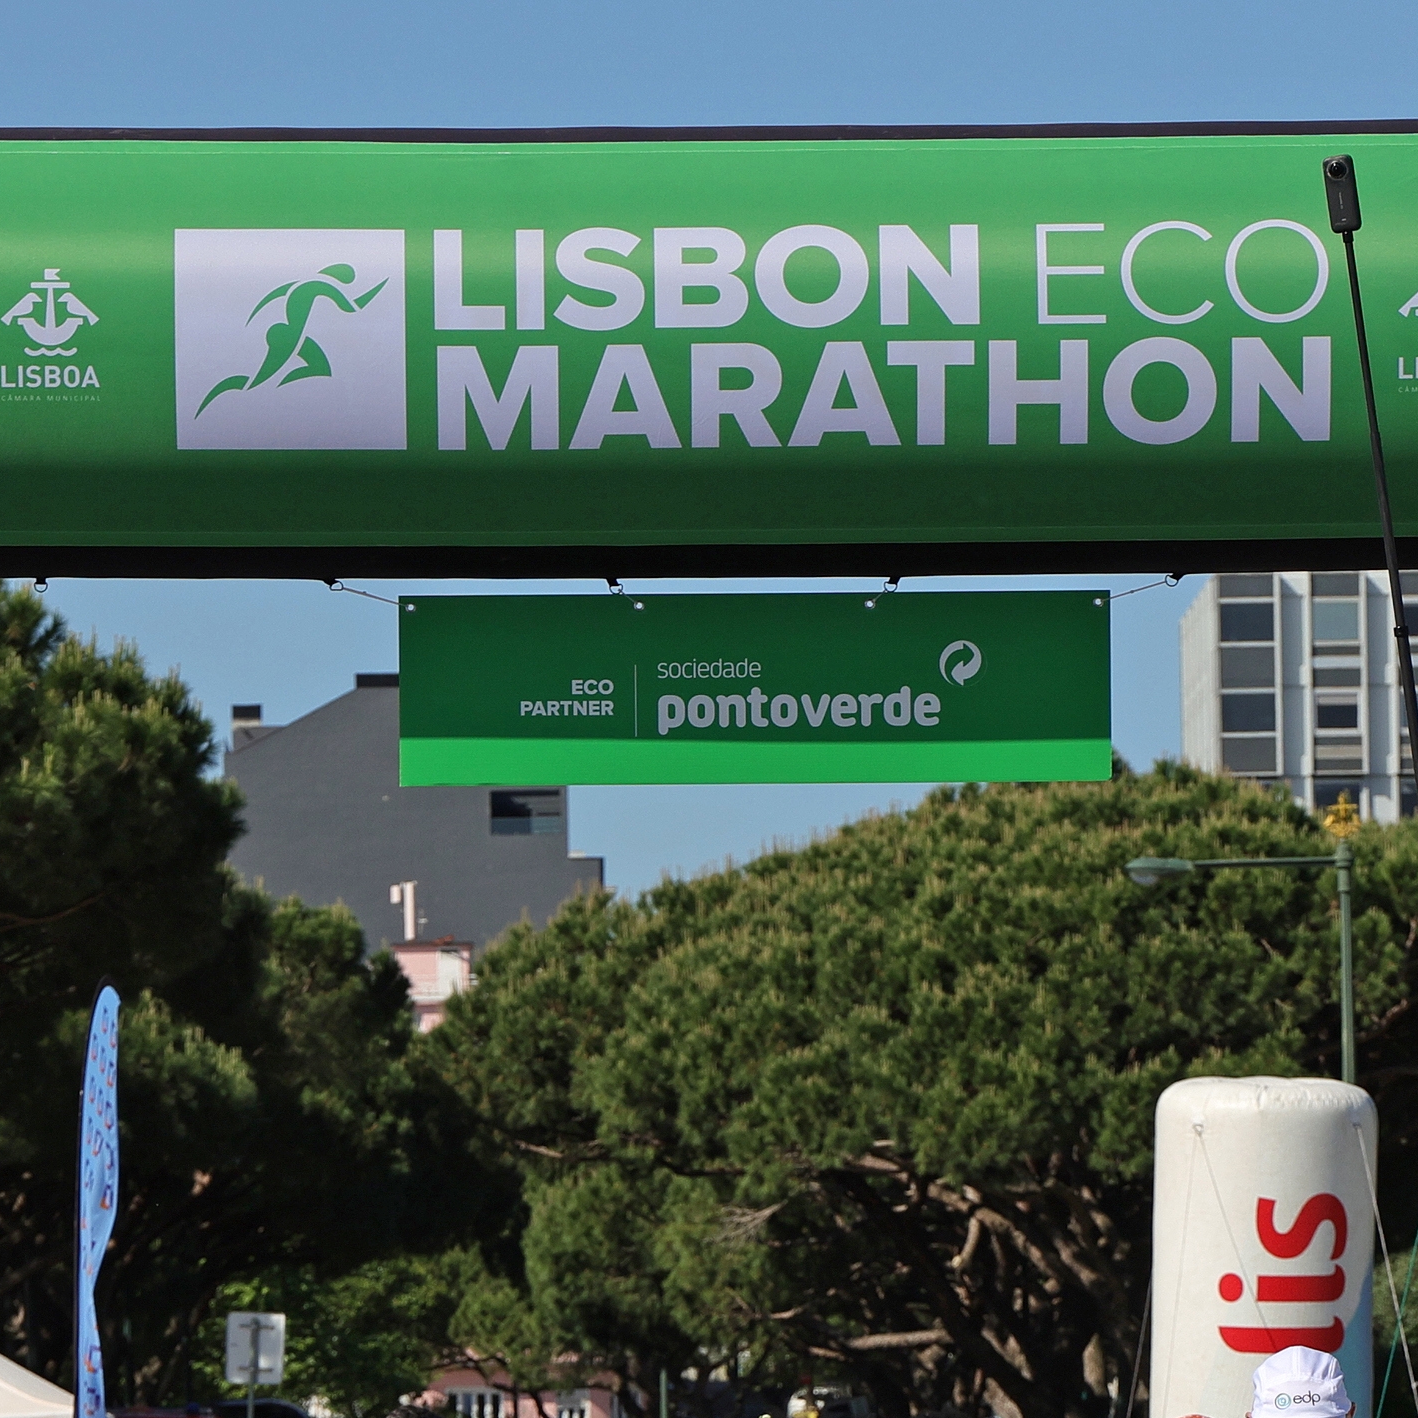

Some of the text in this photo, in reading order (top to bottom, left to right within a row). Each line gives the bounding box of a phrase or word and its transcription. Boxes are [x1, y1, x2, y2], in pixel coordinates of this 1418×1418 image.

[434, 219, 1330, 331] LISBON ECO
[1, 365, 100, 388] LISBOA
[436, 336, 1331, 451] MARATHON
[657, 659, 761, 679] sociedade
[571, 679, 614, 696] ECO
[520, 701, 614, 716] PARTNER
[659, 686, 941, 735] pontoverde
[1293, 1390, 1321, 1406] edp
